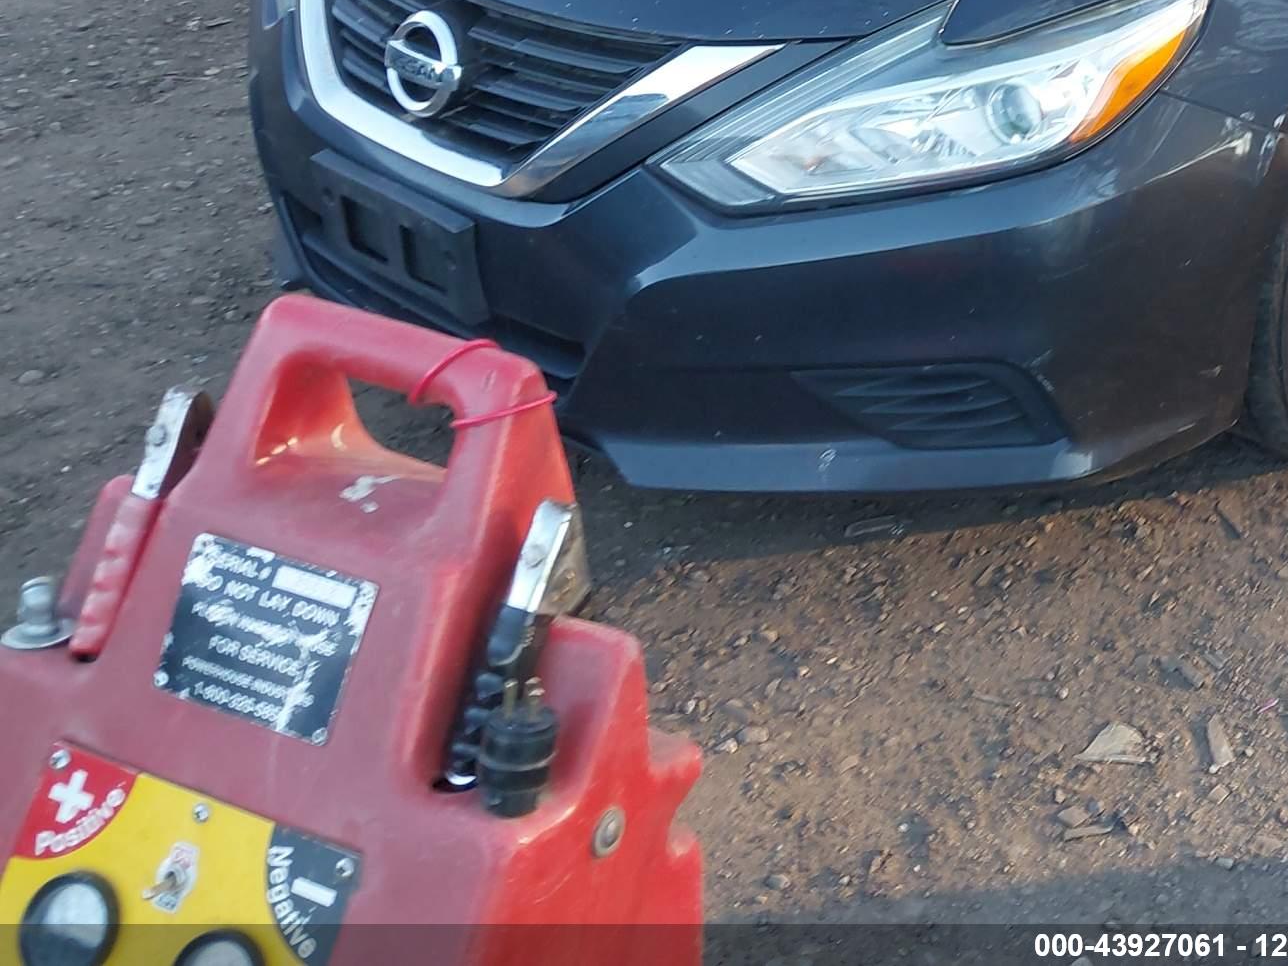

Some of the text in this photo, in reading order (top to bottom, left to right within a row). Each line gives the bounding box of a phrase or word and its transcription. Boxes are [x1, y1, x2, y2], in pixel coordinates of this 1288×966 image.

[223, 580, 260, 602] NOT
[258, 590, 292, 612] LAY
[292, 600, 340, 628] DOWN
[208, 635, 241, 657] FOR
[34, 787, 127, 856] Positive
[266, 845, 317, 959] Negative
